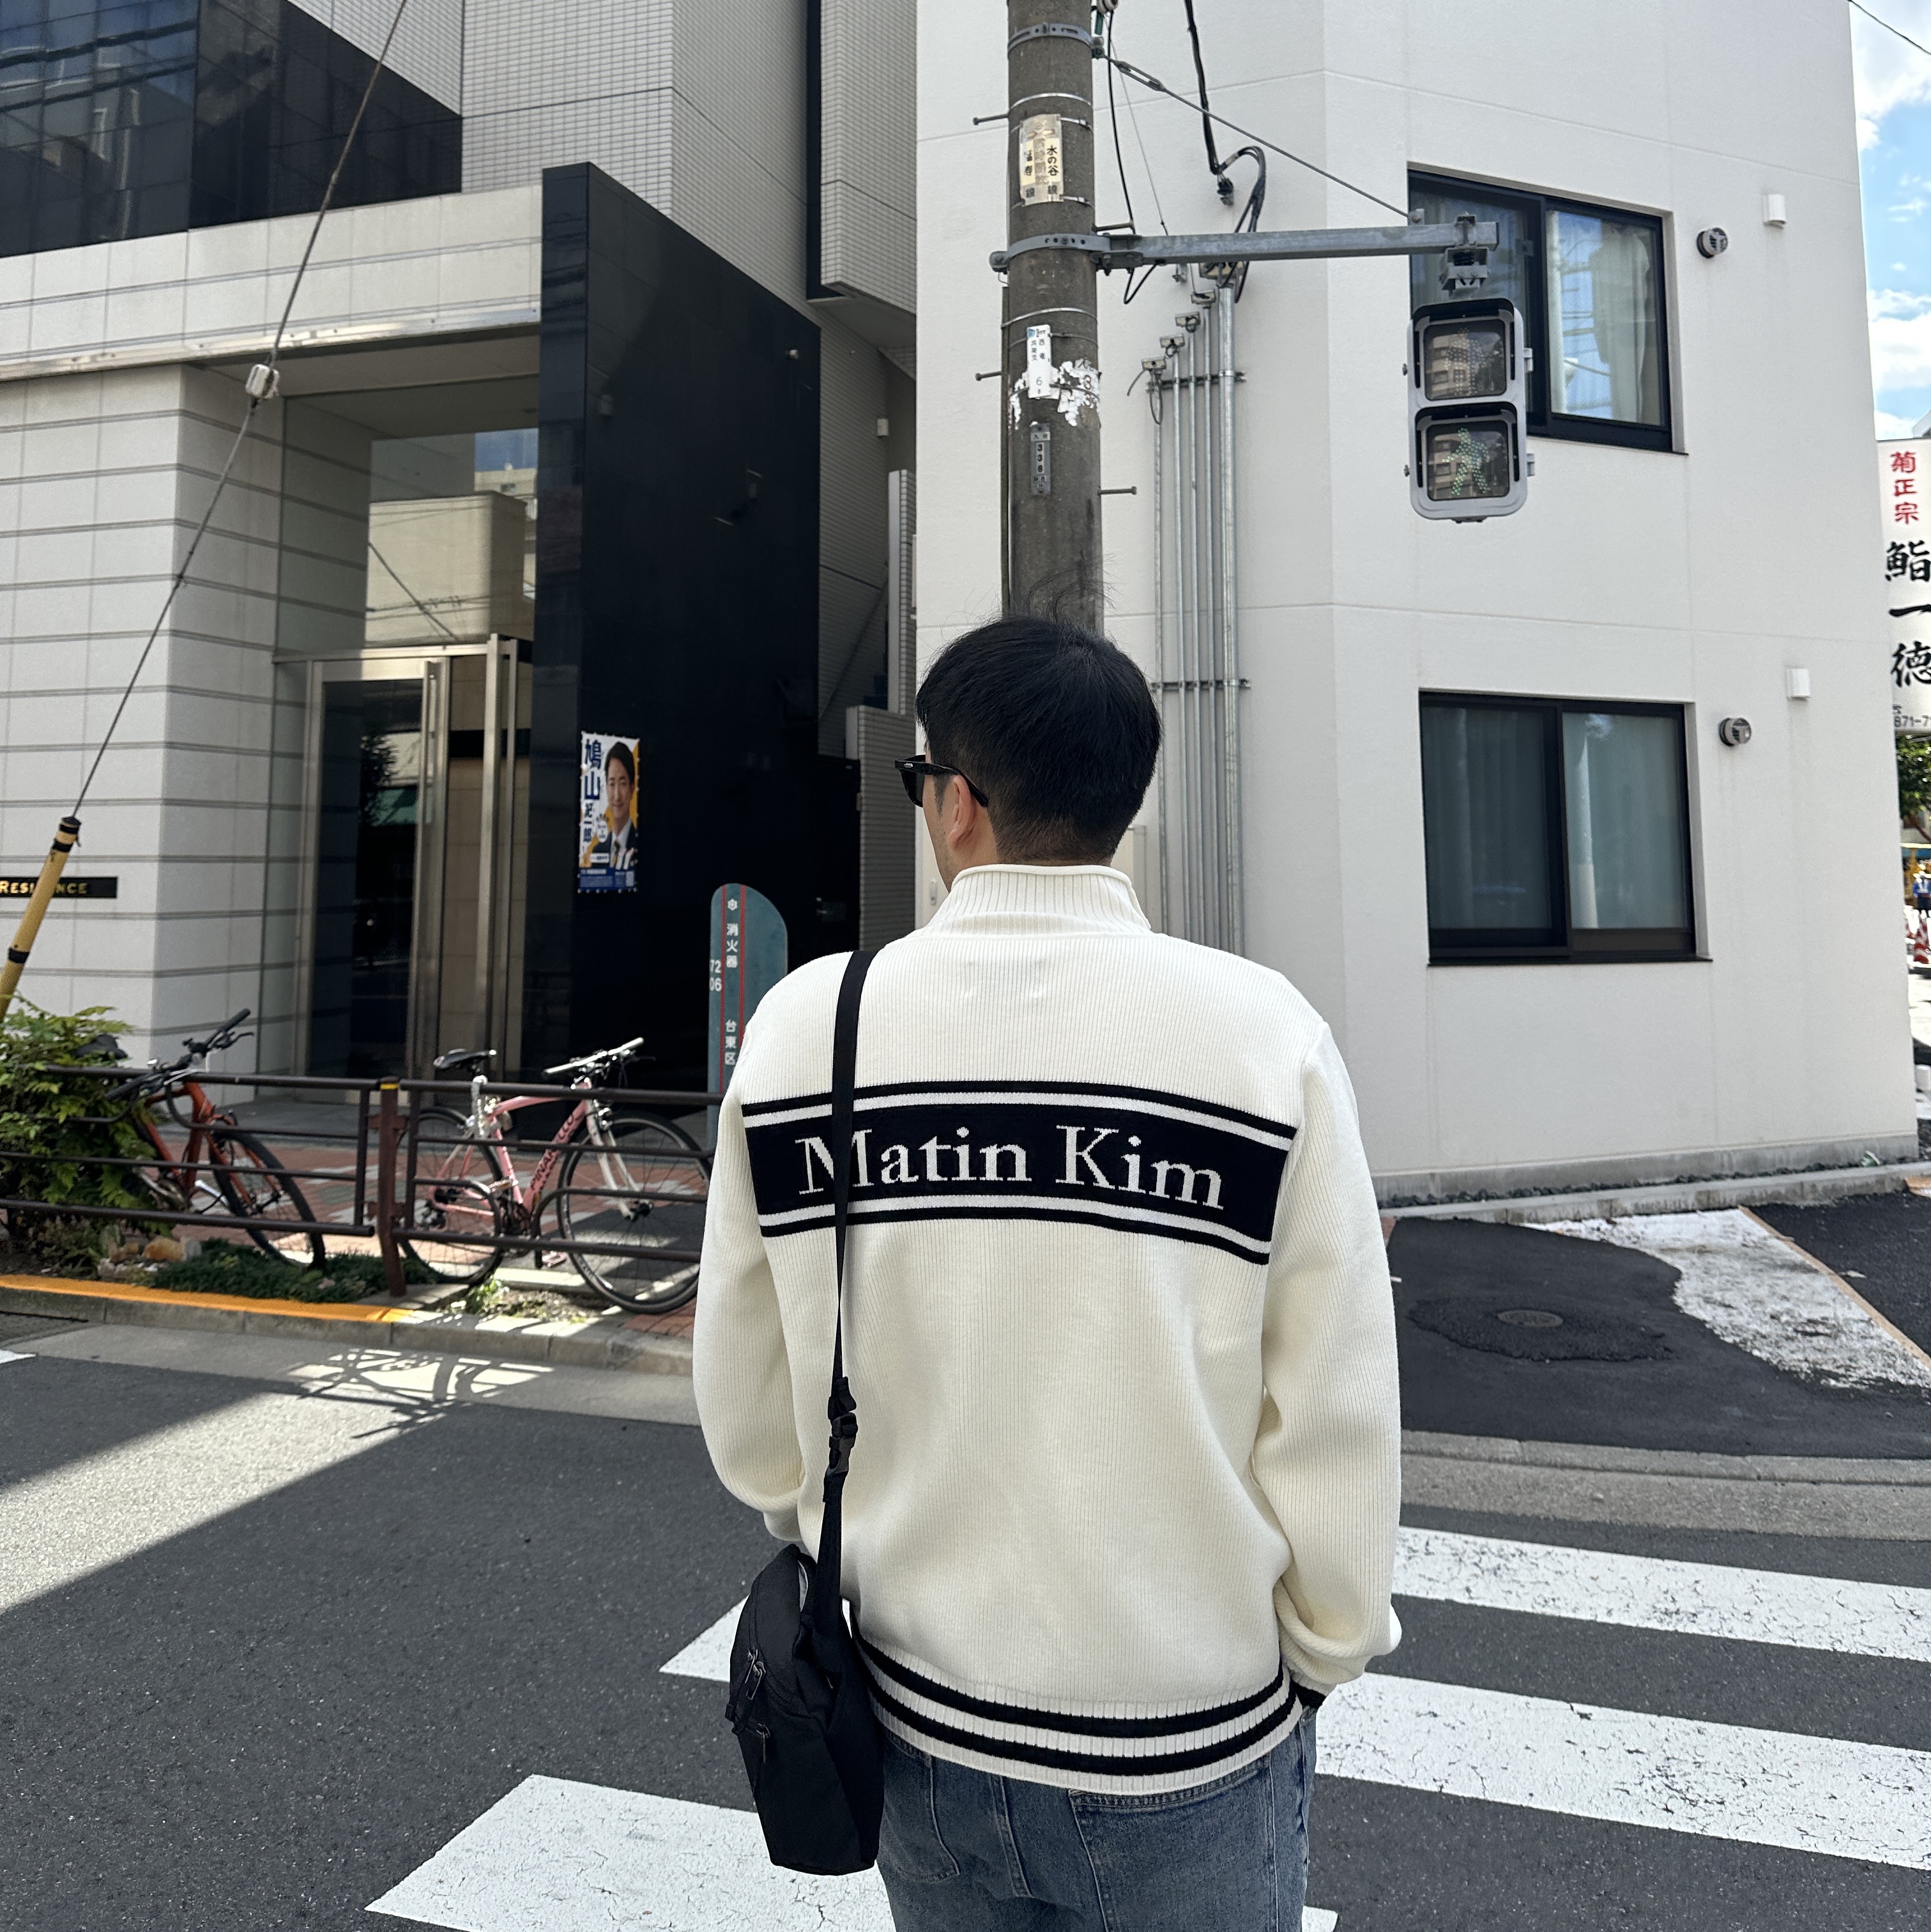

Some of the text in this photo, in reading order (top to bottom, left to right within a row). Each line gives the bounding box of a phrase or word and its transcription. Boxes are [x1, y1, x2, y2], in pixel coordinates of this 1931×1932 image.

[1890, 451, 1920, 525] 菊正宗
[0, 880, 88, 894] RESINCE
[724, 1020, 737, 1066] 台東区
[795, 1124, 1225, 1211] Matin Kim
